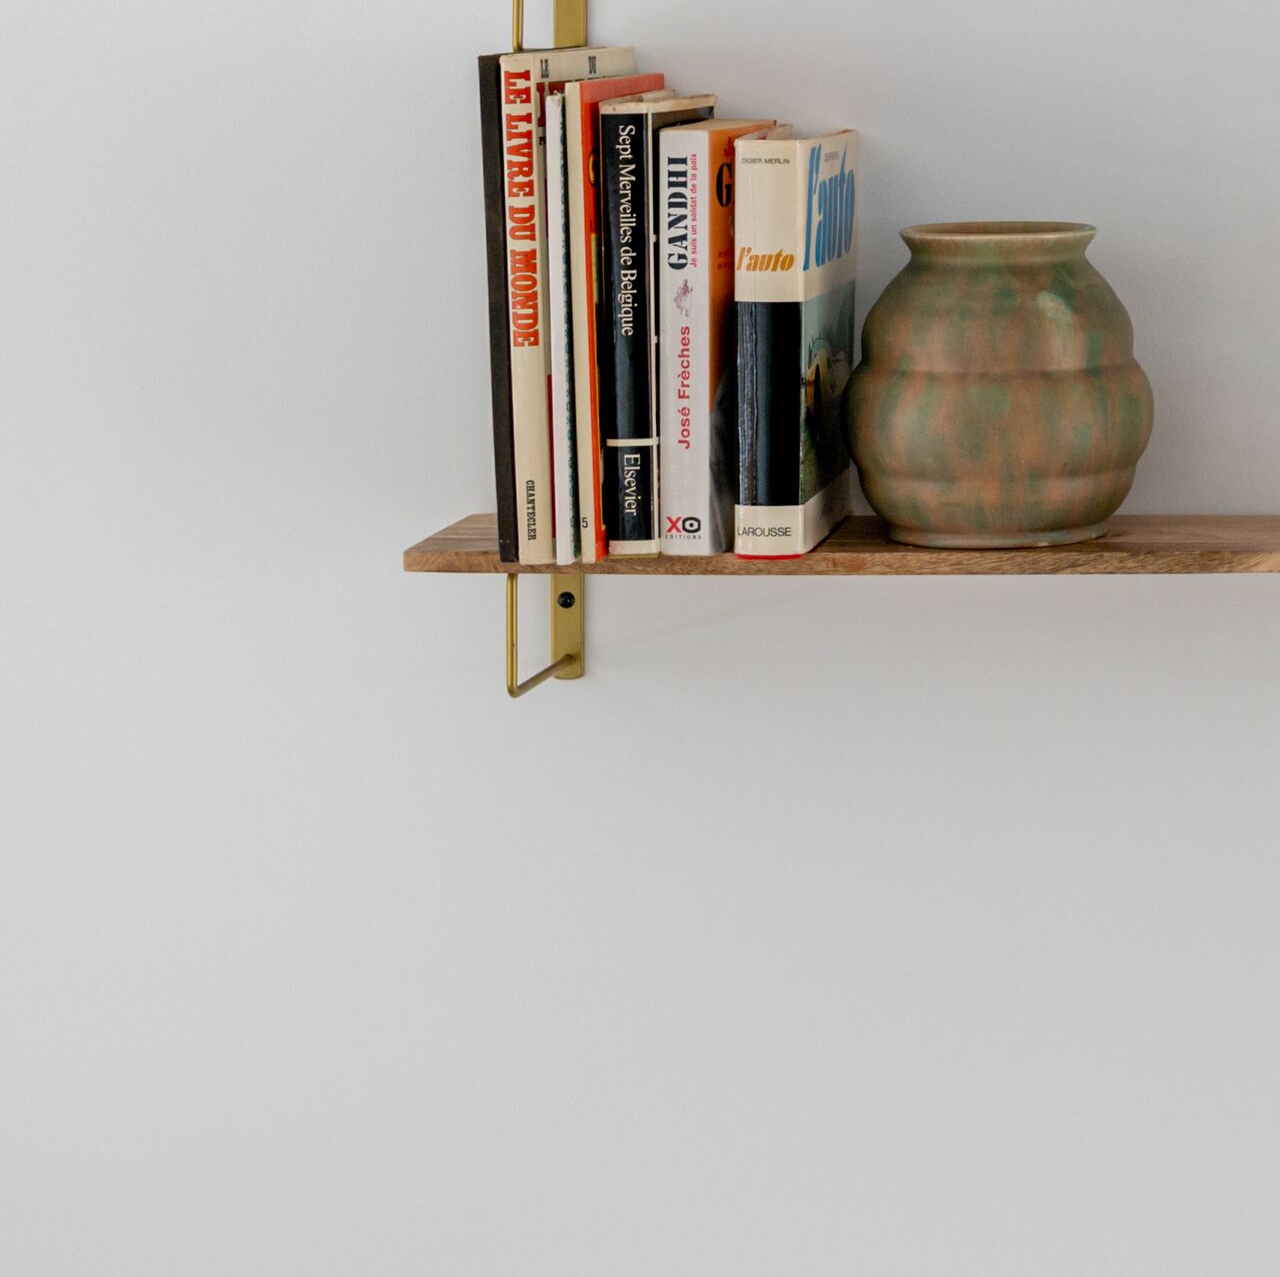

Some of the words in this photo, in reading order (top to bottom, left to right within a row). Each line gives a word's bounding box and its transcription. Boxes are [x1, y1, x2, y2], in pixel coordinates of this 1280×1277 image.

[504, 69, 532, 105] LE
[506, 112, 535, 198] LIVRE
[615, 124, 636, 161] Sept
[690, 153, 700, 172] paix
[690, 173, 698, 182] la
[741, 157, 763, 165] DIDIER
[764, 157, 790, 165] MERLIN
[618, 163, 637, 244] Merveilles
[690, 183, 698, 195] de
[802, 141, 856, 272] l'auto
[508, 204, 537, 242] DU
[667, 156, 689, 271] GANDHI
[690, 196, 698, 222] soldat
[690, 237, 698, 255] suis
[691, 225, 698, 236] un
[620, 247, 637, 266] de
[690, 256, 698, 268] Je
[736, 246, 796, 272] l'auto
[510, 248, 540, 348] MONDE
[617, 268, 638, 337] Belgique
[677, 325, 692, 398] Frèches
[677, 402, 692, 451] José
[623, 453, 641, 516] Elsevier
[525, 479, 537, 541] CHANTECLER
[581, 516, 588, 529] 5
[737, 526, 792, 537] LAROUSSE
